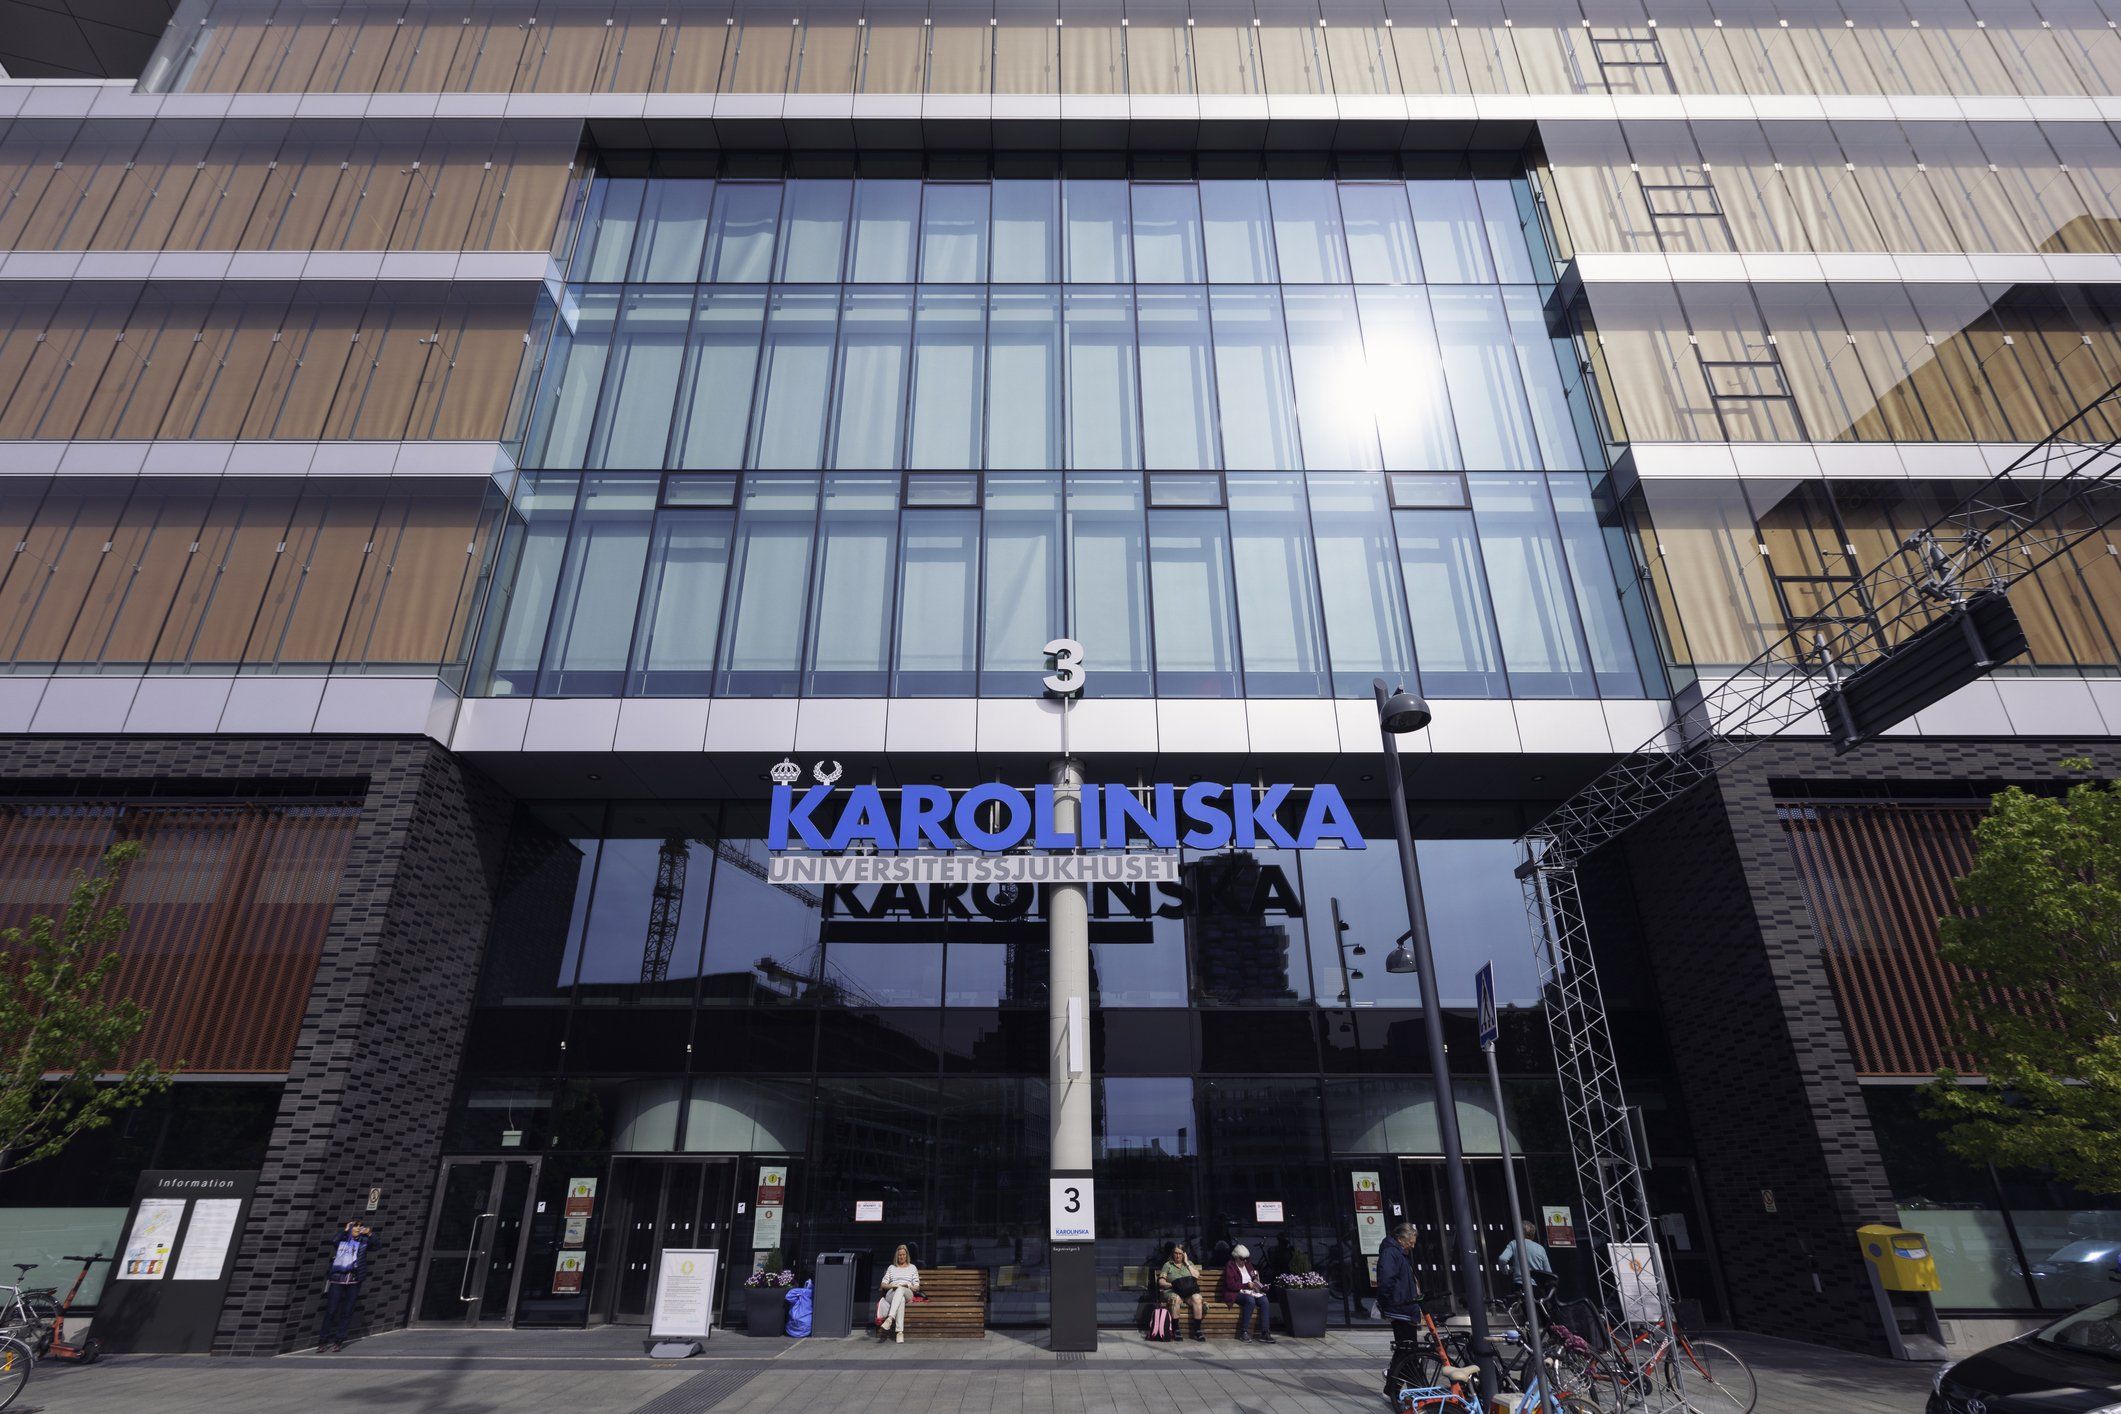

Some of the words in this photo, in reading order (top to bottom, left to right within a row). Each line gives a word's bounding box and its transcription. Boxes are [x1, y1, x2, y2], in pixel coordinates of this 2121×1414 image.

[1042, 638, 1086, 692] 3
[768, 782, 1367, 852] KAROLINSKA
[769, 857, 1178, 882] UNIVERSITETSSJUKHUSET
[158, 1178, 235, 1188] Information
[1064, 1187, 1081, 1214] 3
